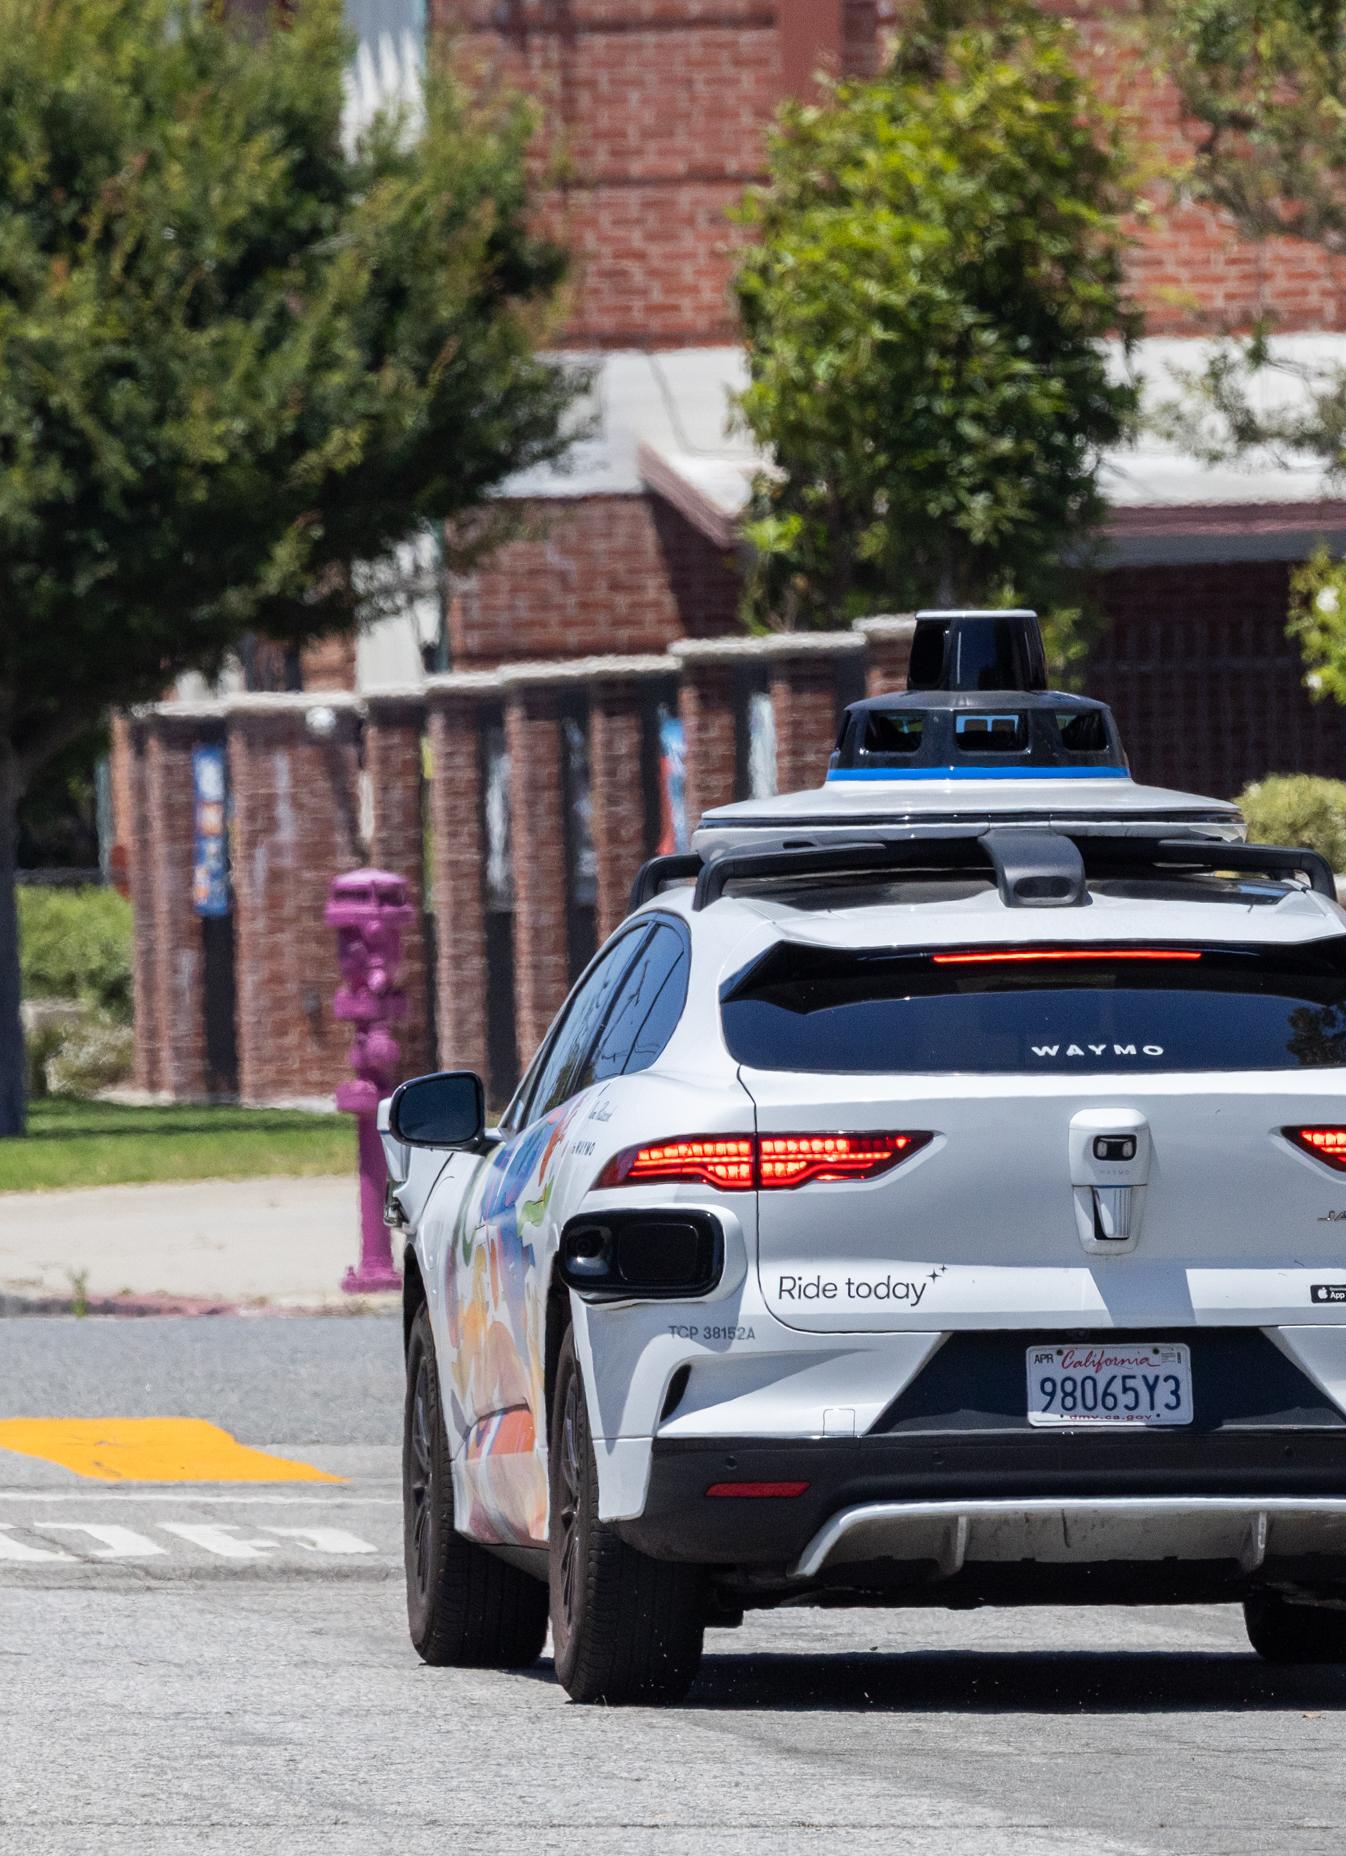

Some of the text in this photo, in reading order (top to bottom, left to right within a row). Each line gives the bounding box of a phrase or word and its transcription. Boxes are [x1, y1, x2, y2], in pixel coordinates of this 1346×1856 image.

[1031, 1044, 1164, 1056] WAYMO
[778, 1275, 927, 1307] Ride today
[1330, 1291, 1346, 1300] App
[668, 1325, 756, 1340] TCP 38152A
[1033, 1354, 1054, 1364] APR
[1061, 1350, 1160, 1373] California
[1040, 1374, 1181, 1412] 98065Y3
